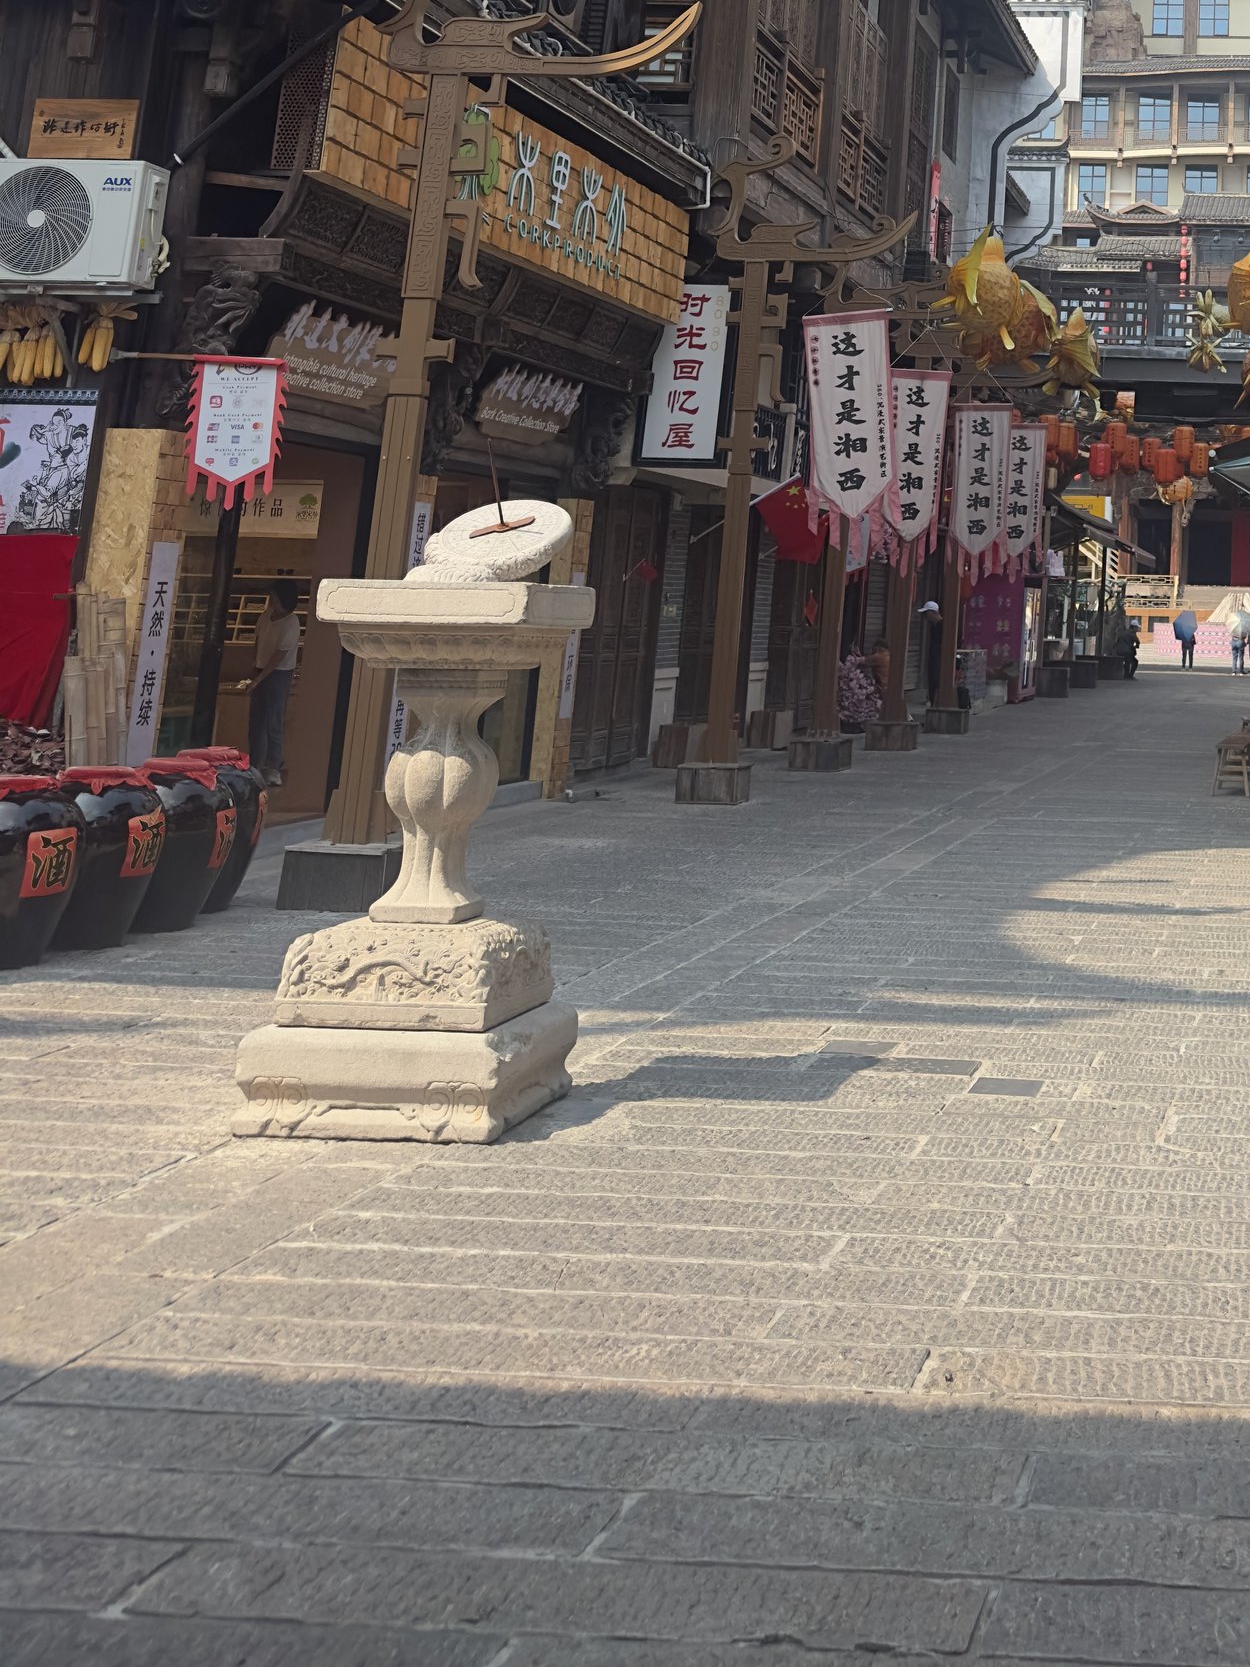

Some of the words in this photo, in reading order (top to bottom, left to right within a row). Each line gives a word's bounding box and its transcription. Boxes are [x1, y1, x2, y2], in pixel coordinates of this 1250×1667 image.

[103, 177, 132, 186] AUX
[504, 213, 622, 280] CORKPRODUCT
[308, 377, 348, 396] collection
[344, 386, 365, 400] store
[319, 362, 351, 382] cultural
[346, 367, 378, 388] heritage
[661, 293, 712, 449] 时光回忆屋
[831, 332, 868, 493] 这才是湘西
[480, 406, 497, 421] Bark
[495, 410, 520, 426] Creative
[519, 415, 547, 430] Collection
[544, 421, 560, 434] Store
[898, 386, 931, 522] 这才是湘西
[965, 417, 994, 536] 这才是湘西
[1006, 435, 1032, 540] 这才是湘西
[136, 581, 169, 727] 天然·持续
[31, 834, 75, 890] 酒
